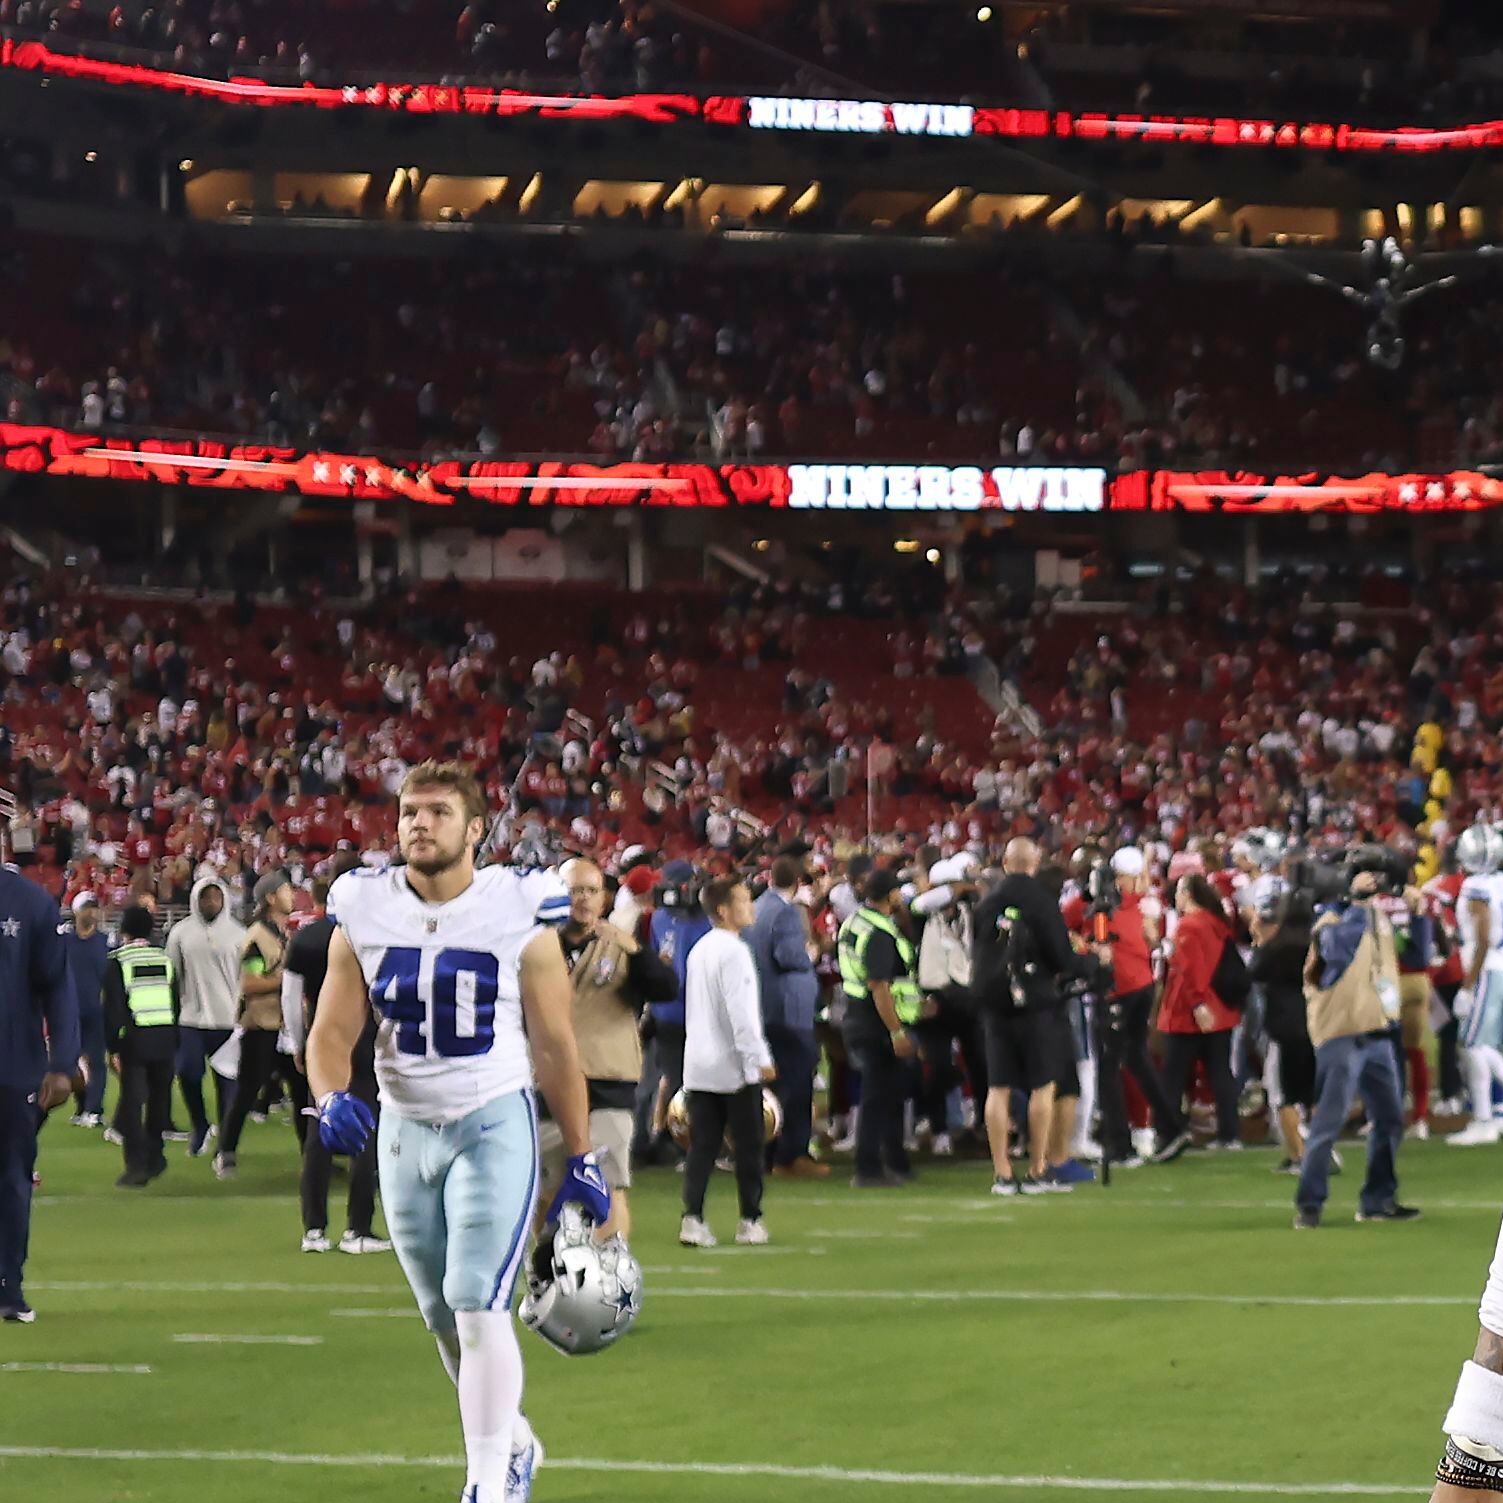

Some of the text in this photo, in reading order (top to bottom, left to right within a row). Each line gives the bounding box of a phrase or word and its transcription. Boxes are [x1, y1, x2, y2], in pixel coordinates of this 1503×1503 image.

[749, 97, 975, 137] NINERS WIN
[788, 465, 1106, 512] NINERS WIN
[370, 946, 499, 1058] 40
[1485, 1466, 1498, 1477] BE
